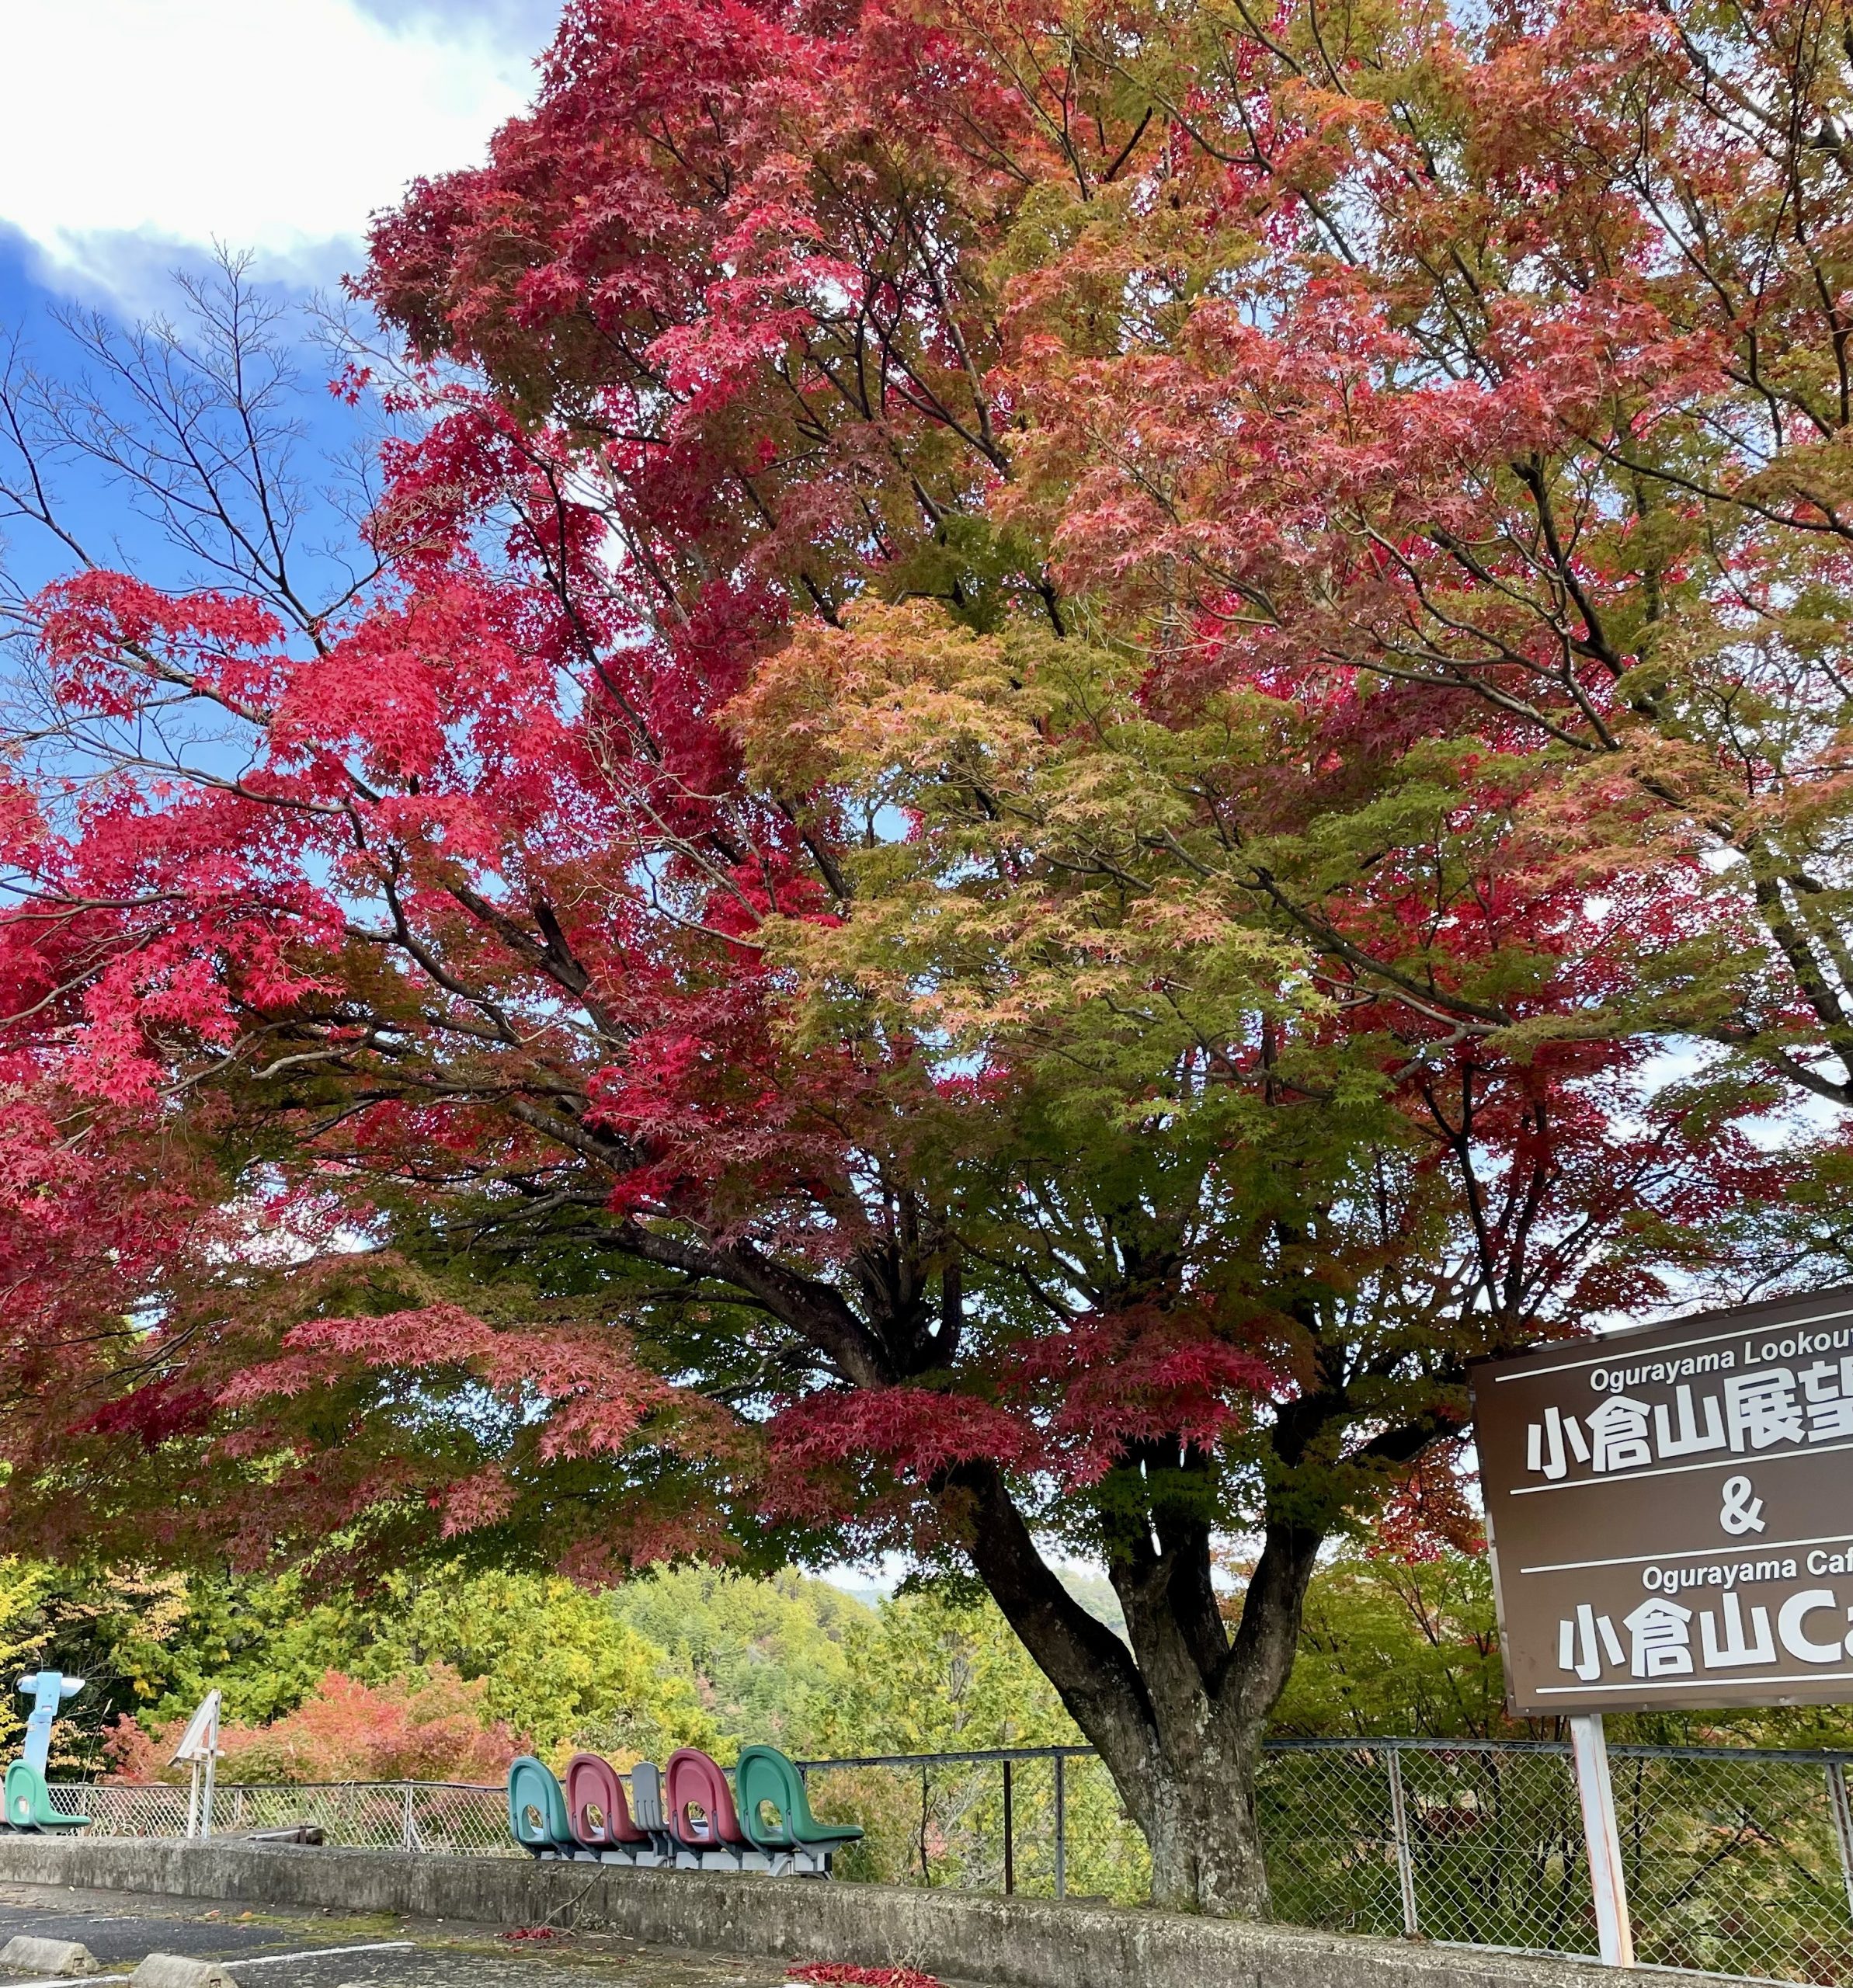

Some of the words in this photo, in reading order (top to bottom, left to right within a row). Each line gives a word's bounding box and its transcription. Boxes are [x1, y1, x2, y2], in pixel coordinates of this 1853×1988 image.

[1590, 1350, 1736, 1394] Ogurayama
[1743, 1328, 1853, 1365] Lookou
[1719, 1475, 1767, 1535] &
[1642, 1558, 1797, 1595] Ogurayama
[1559, 1589, 1853, 1681] 小倉山C
